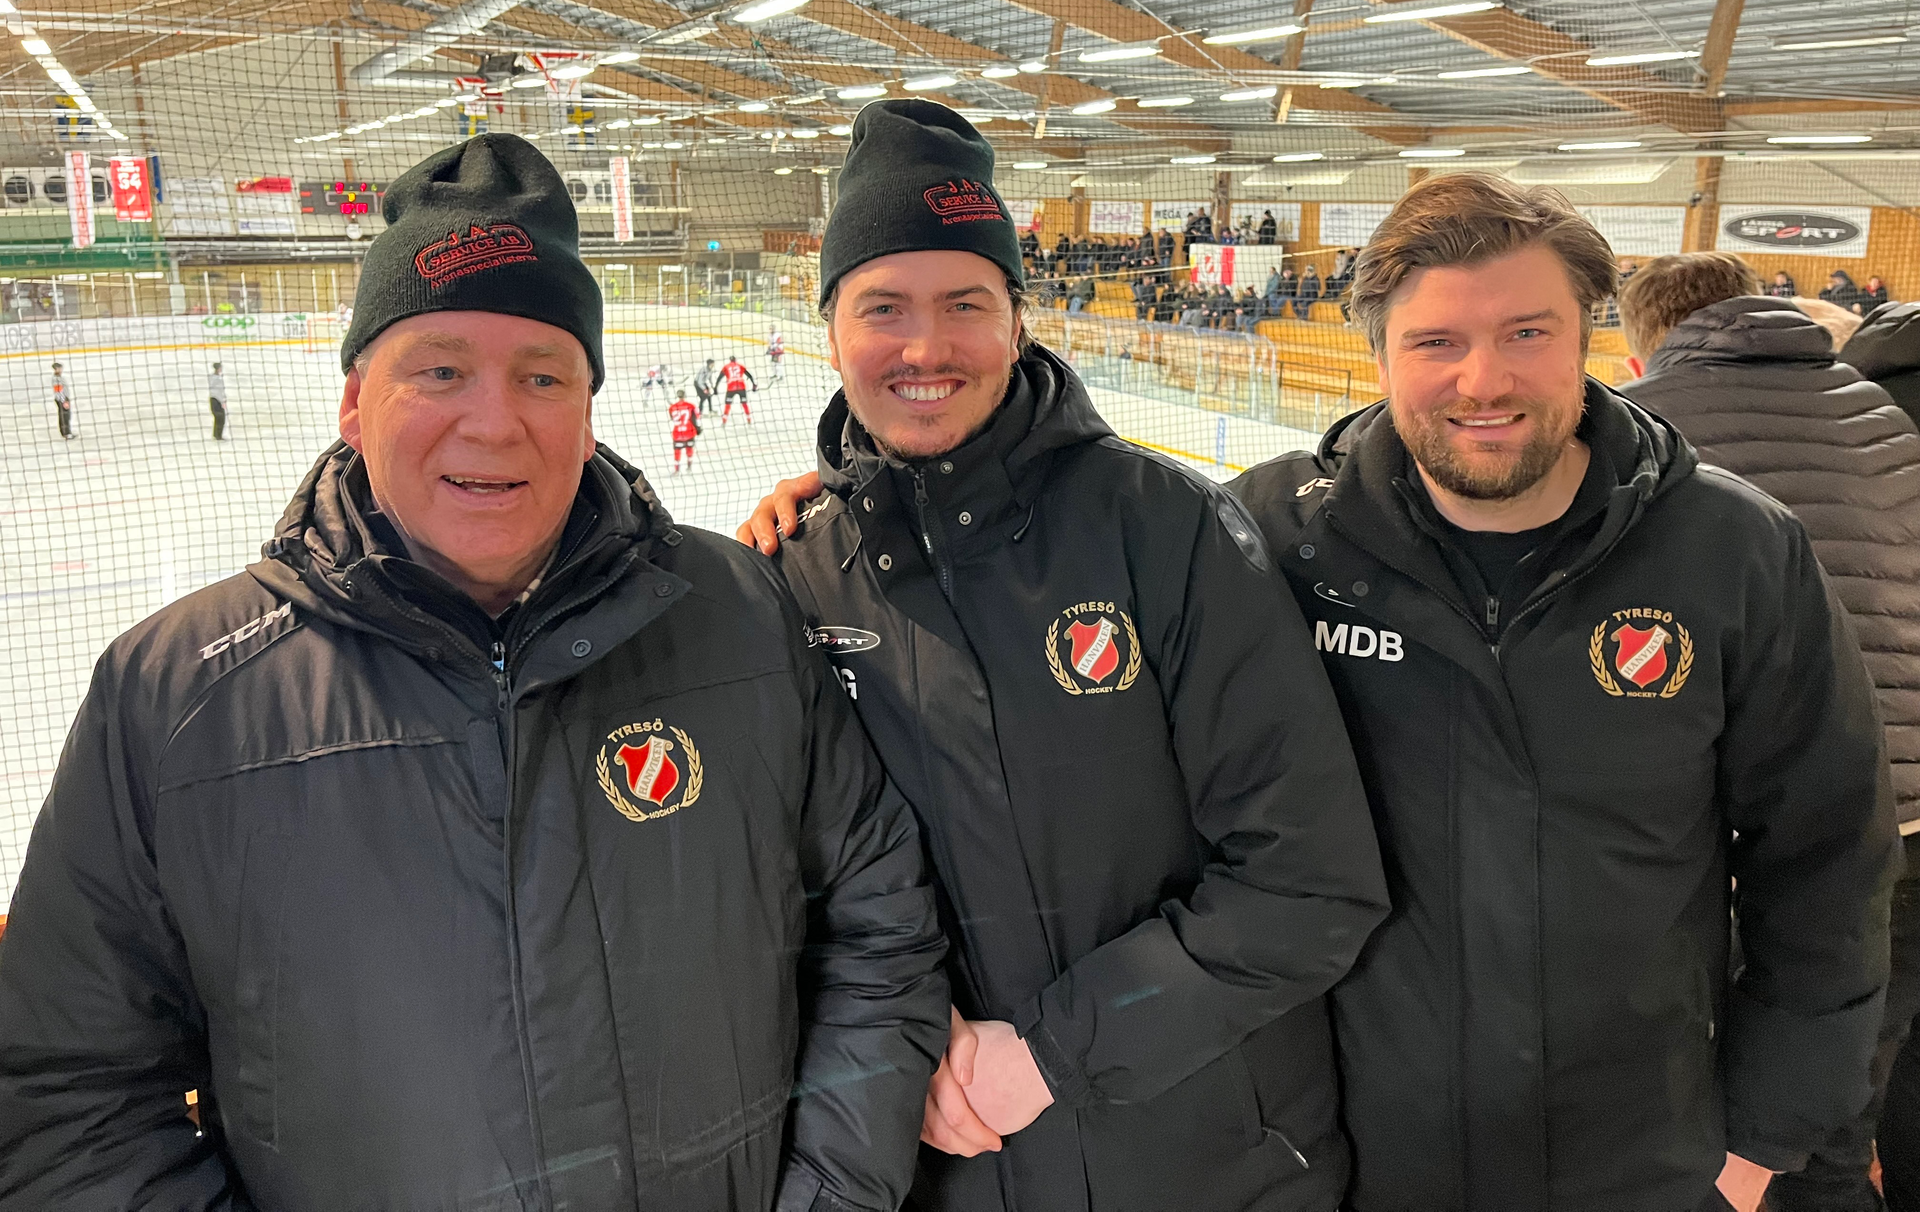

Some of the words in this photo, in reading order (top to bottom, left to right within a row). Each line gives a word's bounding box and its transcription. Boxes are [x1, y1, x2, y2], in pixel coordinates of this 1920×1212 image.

[939, 194, 981, 207] SERVICE
[1741, 226, 1846, 239] SPORT
[430, 238, 498, 266] SERVICE
[500, 235, 520, 246] AB
[430, 255, 538, 290] Arenaspecialisterna
[671, 409, 690, 427] 27
[1062, 601, 1116, 619] TYRESÖ
[1612, 607, 1673, 623] TYRESÖ
[198, 601, 292, 660] CCM
[1315, 620, 1404, 662] MDB
[1079, 622, 1111, 673] HANVIKEN
[1623, 630, 1665, 676] HANVIKEN
[1085, 686, 1114, 695] HOCKEY
[607, 718, 664, 743] TYRESÖ
[638, 740, 663, 796] HANVIKEN
[648, 803, 681, 819] HOCKEY
